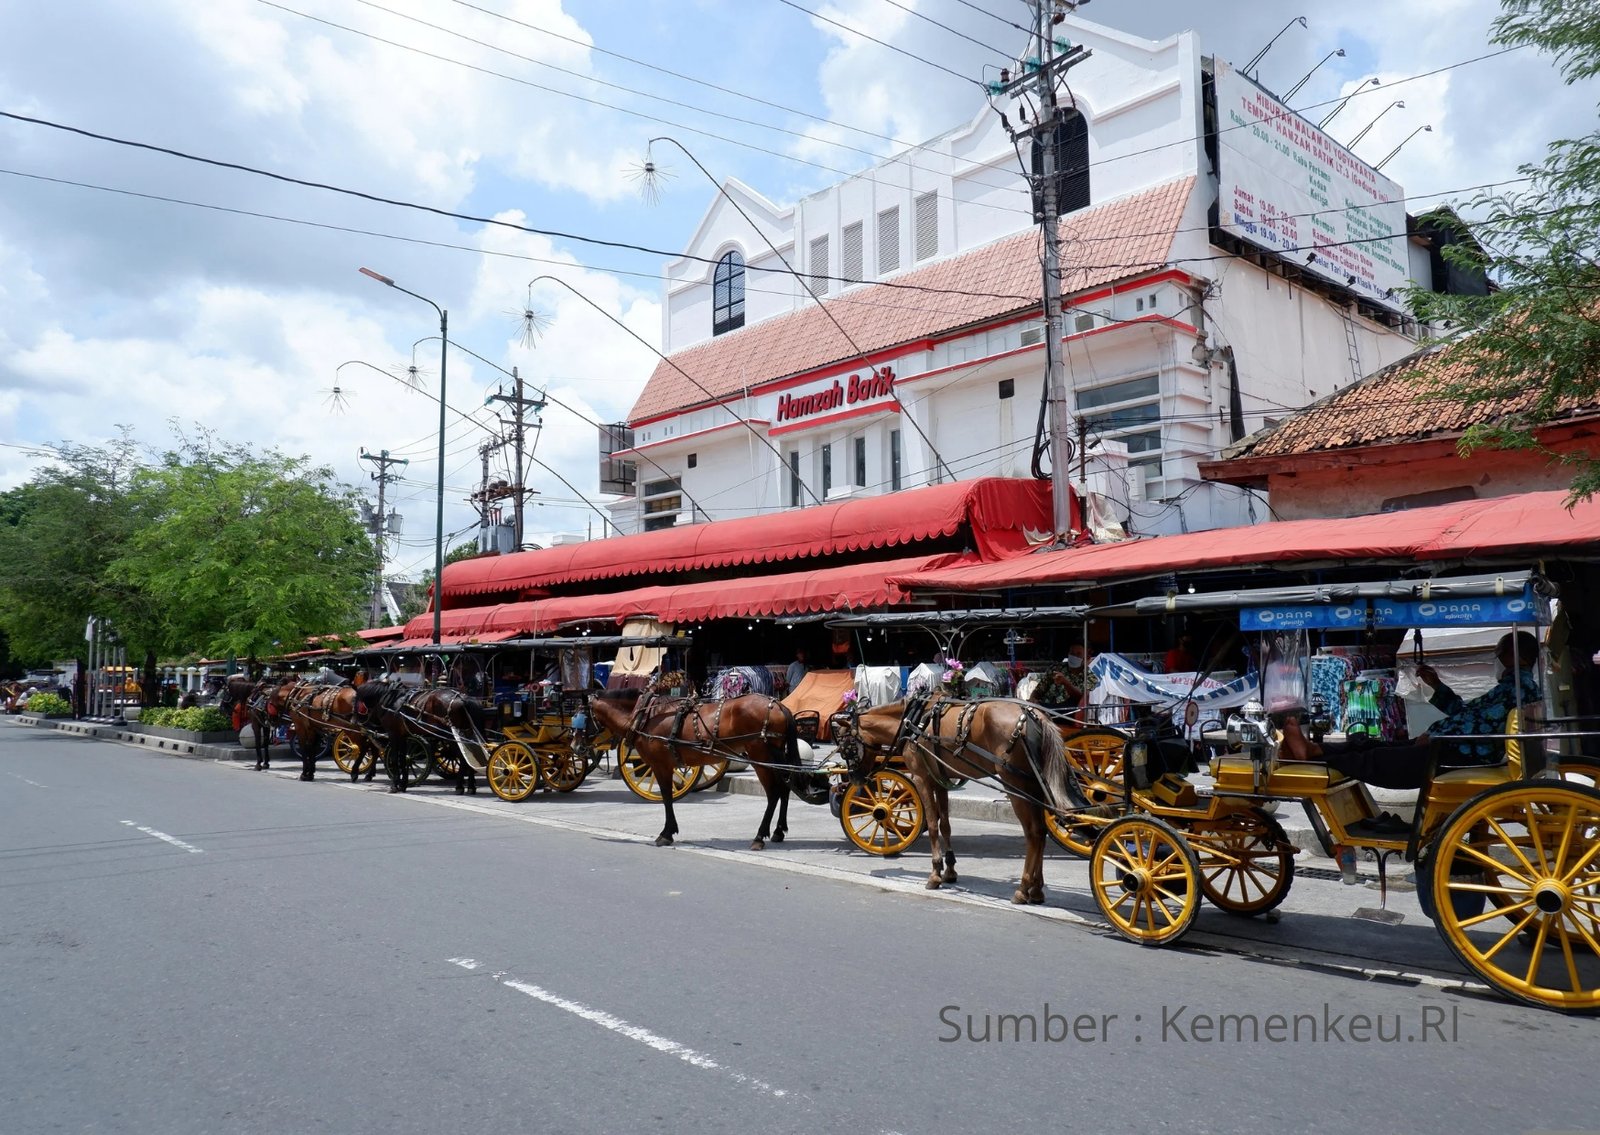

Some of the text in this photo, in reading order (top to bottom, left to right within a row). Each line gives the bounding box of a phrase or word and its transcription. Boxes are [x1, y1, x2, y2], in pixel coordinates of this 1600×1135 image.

[1241, 96, 1273, 127] TEMPAT
[1276, 120, 1310, 152] HAMZAH
[1313, 145, 1333, 168] BATIK
[1256, 92, 1376, 184] HIBURAN MALAM DI YOGYAKARTA
[1234, 185, 1254, 204] Jumat
[1259, 199, 1275, 216] 19.00
[1281, 211, 1296, 228] 20.00
[1234, 198, 1253, 218] Sabtu
[1260, 213, 1276, 229] 19.00
[1282, 224, 1297, 241] 20.00
[1260, 226, 1277, 243] 19.00
[1282, 237, 1298, 254] 20.00
[777, 366, 896, 422] Hamzah Batik
[1277, 611, 1313, 619] DANA
[1354, 607, 1393, 616] DNA
[1439, 604, 1481, 612] DANA
